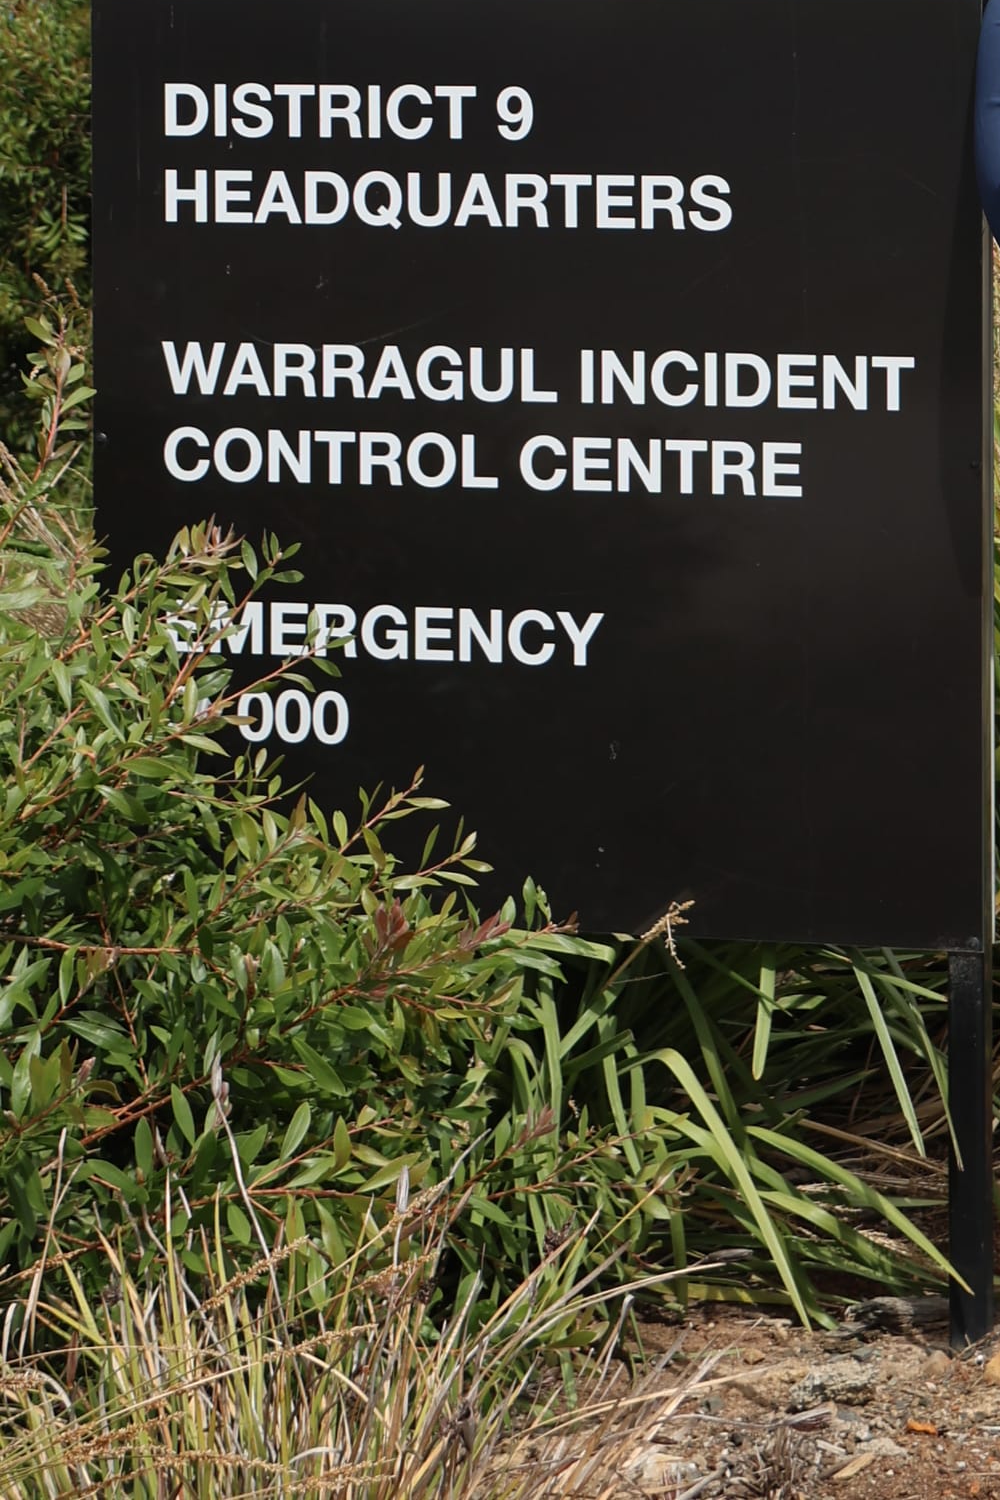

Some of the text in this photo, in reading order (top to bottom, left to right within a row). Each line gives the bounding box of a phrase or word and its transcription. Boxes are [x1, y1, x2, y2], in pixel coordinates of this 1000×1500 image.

[164, 82, 534, 141] DISTRICT 9
[164, 169, 733, 232] HEADQUARTERS
[161, 340, 915, 412] WARRAGUL INCIDENT
[163, 426, 803, 498] CONTROL CENTRE
[237, 688, 350, 745] 000
